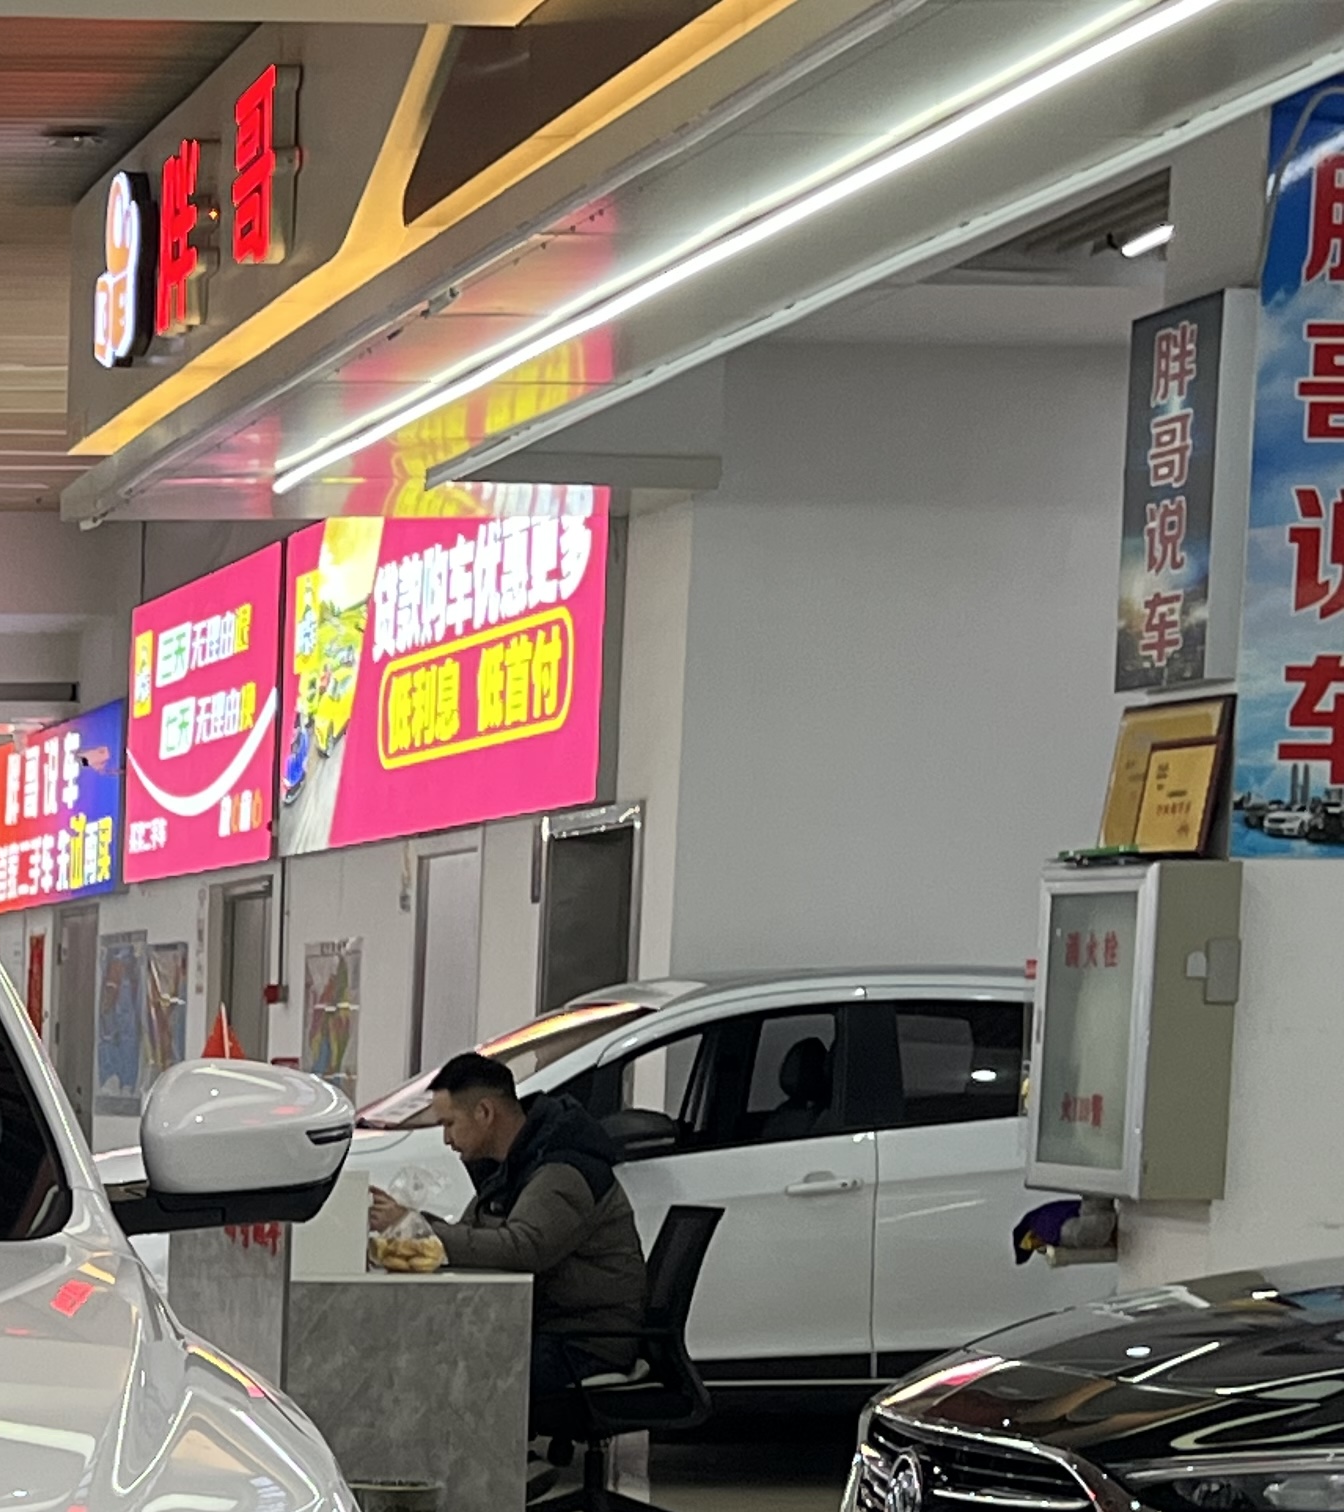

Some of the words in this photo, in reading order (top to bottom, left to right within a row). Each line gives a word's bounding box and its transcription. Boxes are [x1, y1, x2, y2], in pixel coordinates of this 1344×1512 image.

[1138, 319, 1199, 668] 胖哥说车
[388, 657, 460, 754] 低利息
[477, 624, 563, 732] 低首付
